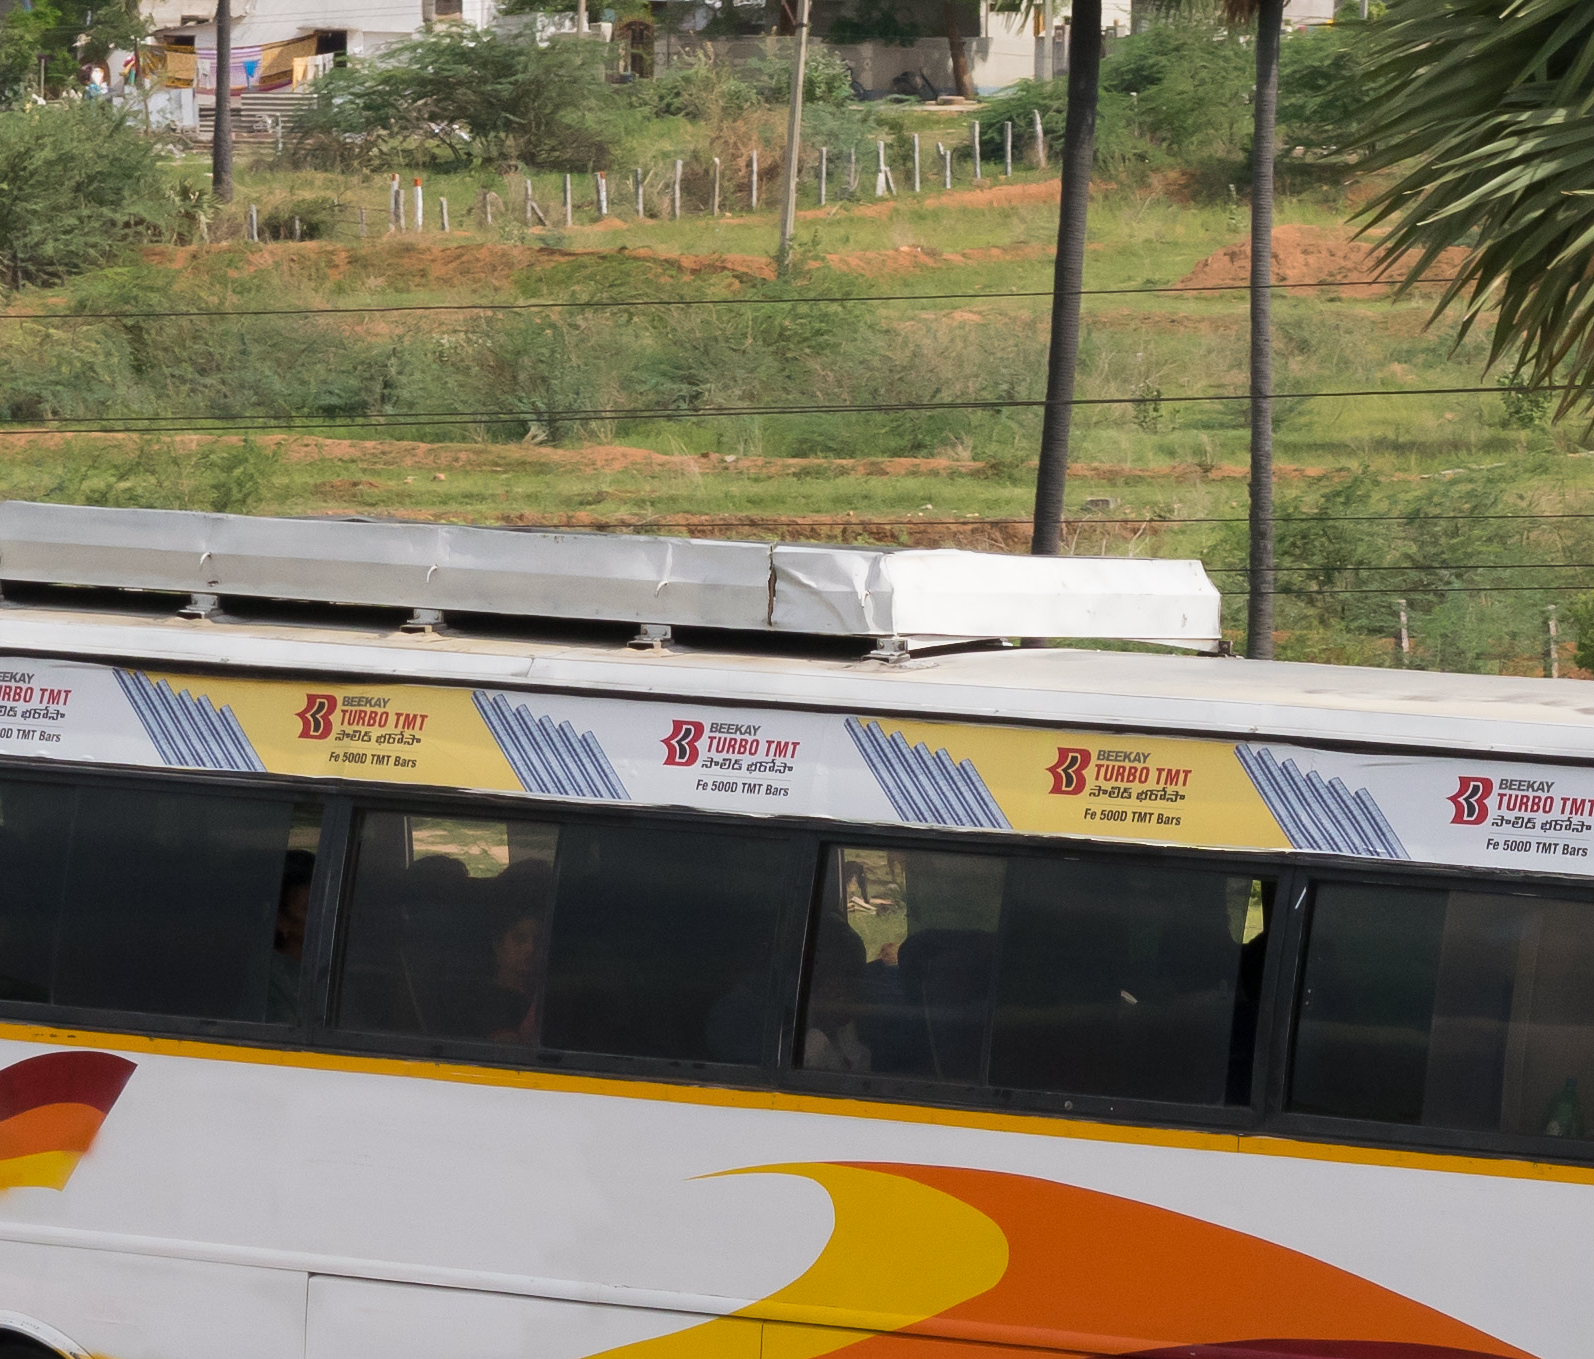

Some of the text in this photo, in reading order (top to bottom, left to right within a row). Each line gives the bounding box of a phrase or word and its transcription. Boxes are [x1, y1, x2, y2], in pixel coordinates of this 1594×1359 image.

[39, 688, 72, 705] TMT
[342, 696, 390, 708] BEEKAY
[340, 709, 428, 731] TURBO TMT
[17, 729, 37, 740] TMT
[39, 731, 61, 742] Bars
[709, 723, 761, 736] BEEKAY
[707, 736, 800, 758] TURBO TMT
[329, 752, 416, 768] Fe 500D TMT Bars
[1097, 750, 1151, 763] BEEKAY
[1094, 764, 1192, 786] TURBO TMT
[696, 779, 789, 796] Fe 500D TMT Bars
[1499, 779, 1554, 793] BEEKAY
[1497, 793, 1554, 814] TURBO
[1084, 808, 1181, 825] Fe 500D TMT Bars
[1486, 839, 1588, 857] Fe 500D TMT Bars
